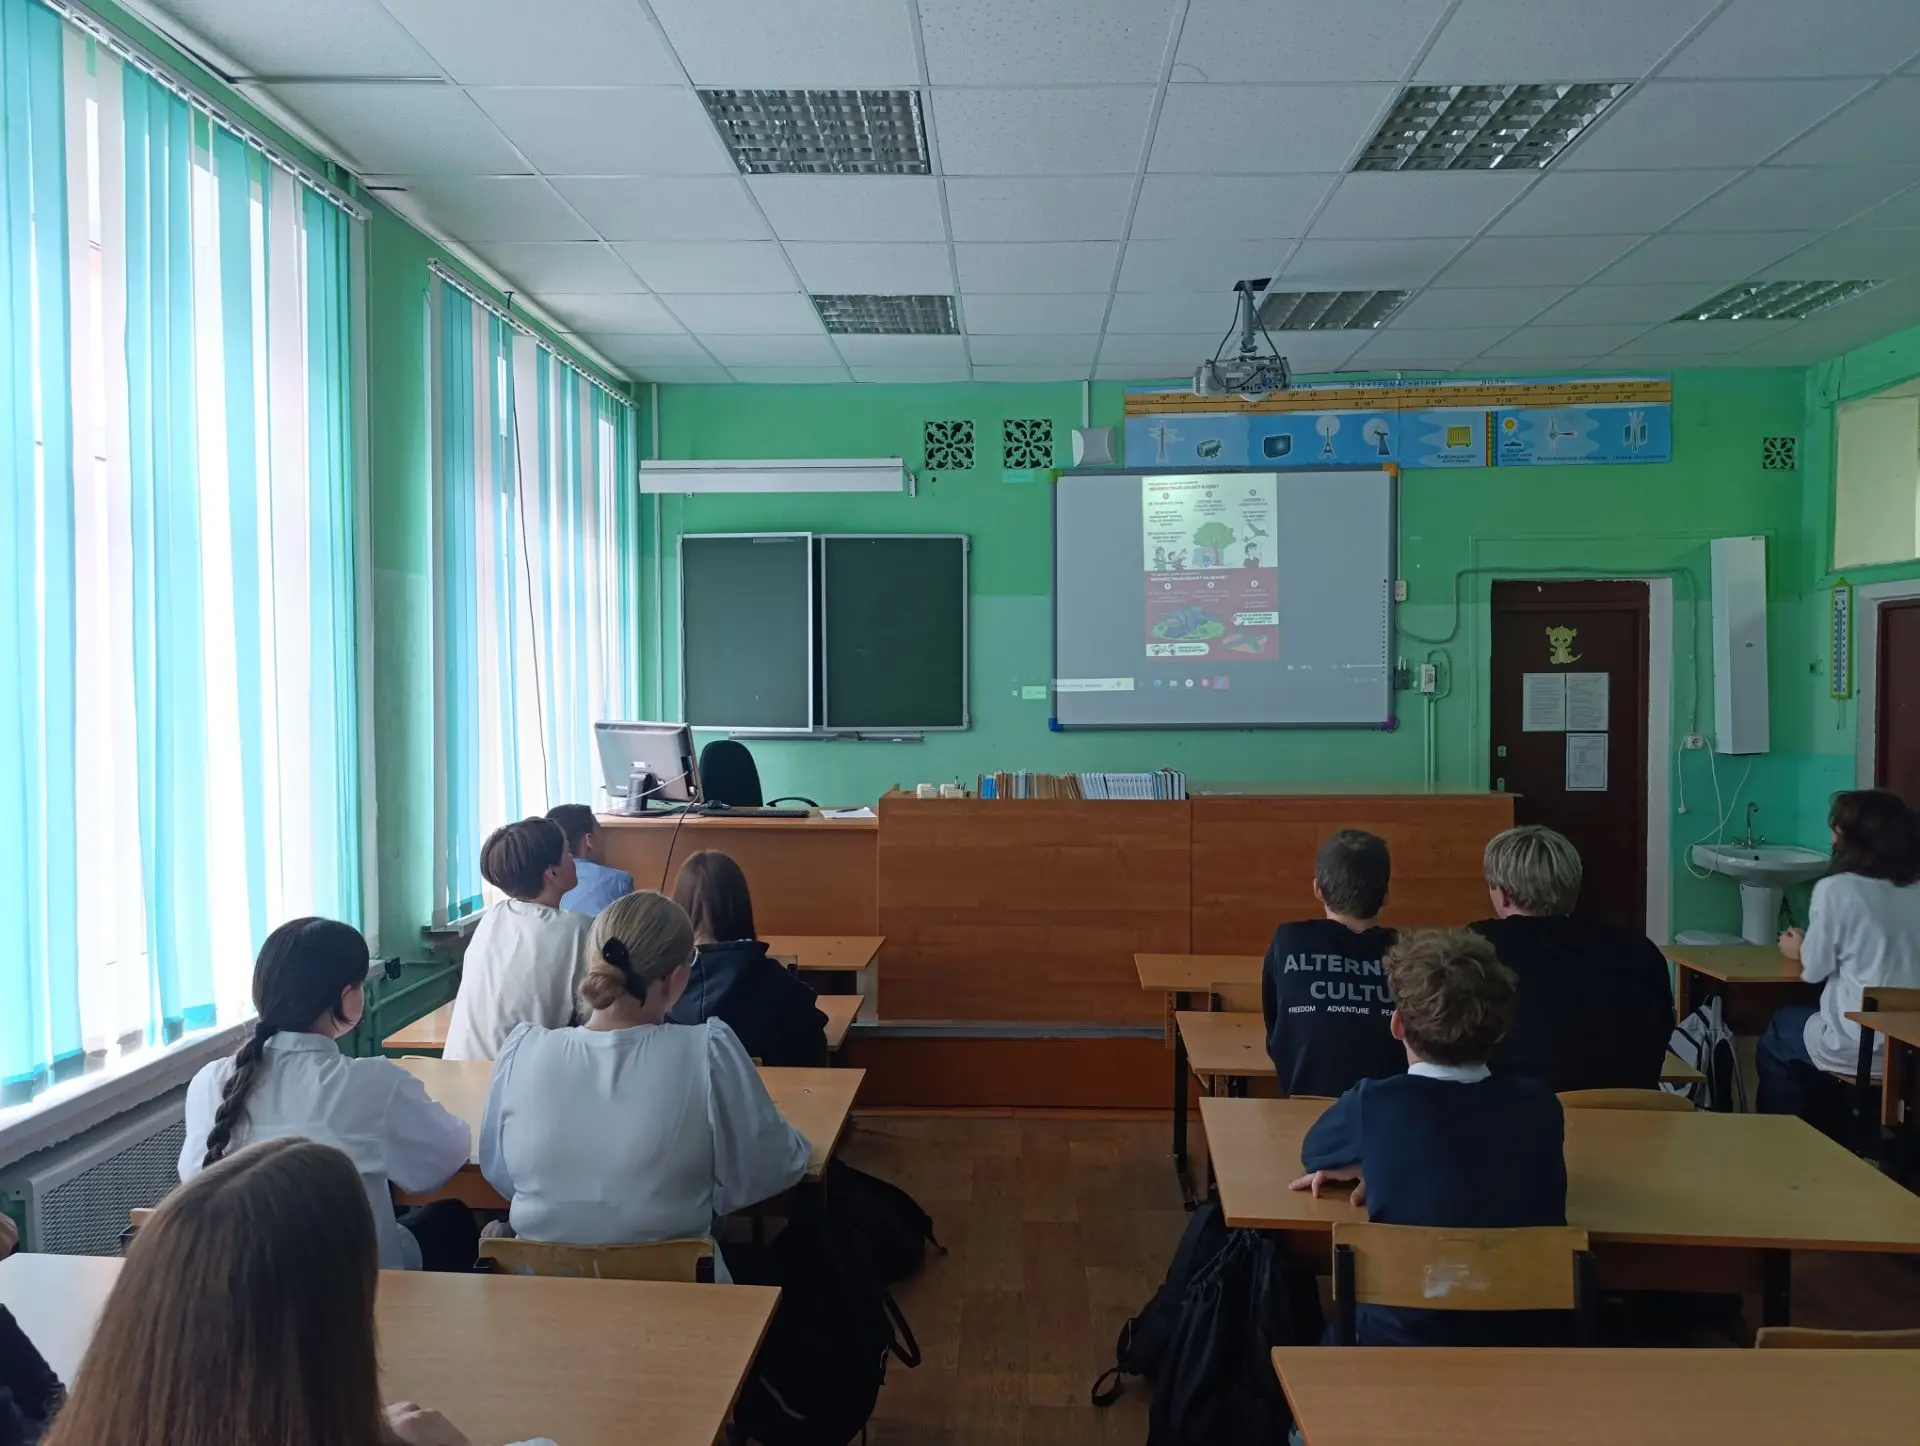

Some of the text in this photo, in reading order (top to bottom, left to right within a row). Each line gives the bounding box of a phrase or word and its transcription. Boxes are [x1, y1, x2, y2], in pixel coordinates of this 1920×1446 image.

[1284, 953, 1388, 976] ALTERN
[1288, 1005, 1316, 1014] FREEDOM
[1327, 1005, 1370, 1015] ADVENTURE
